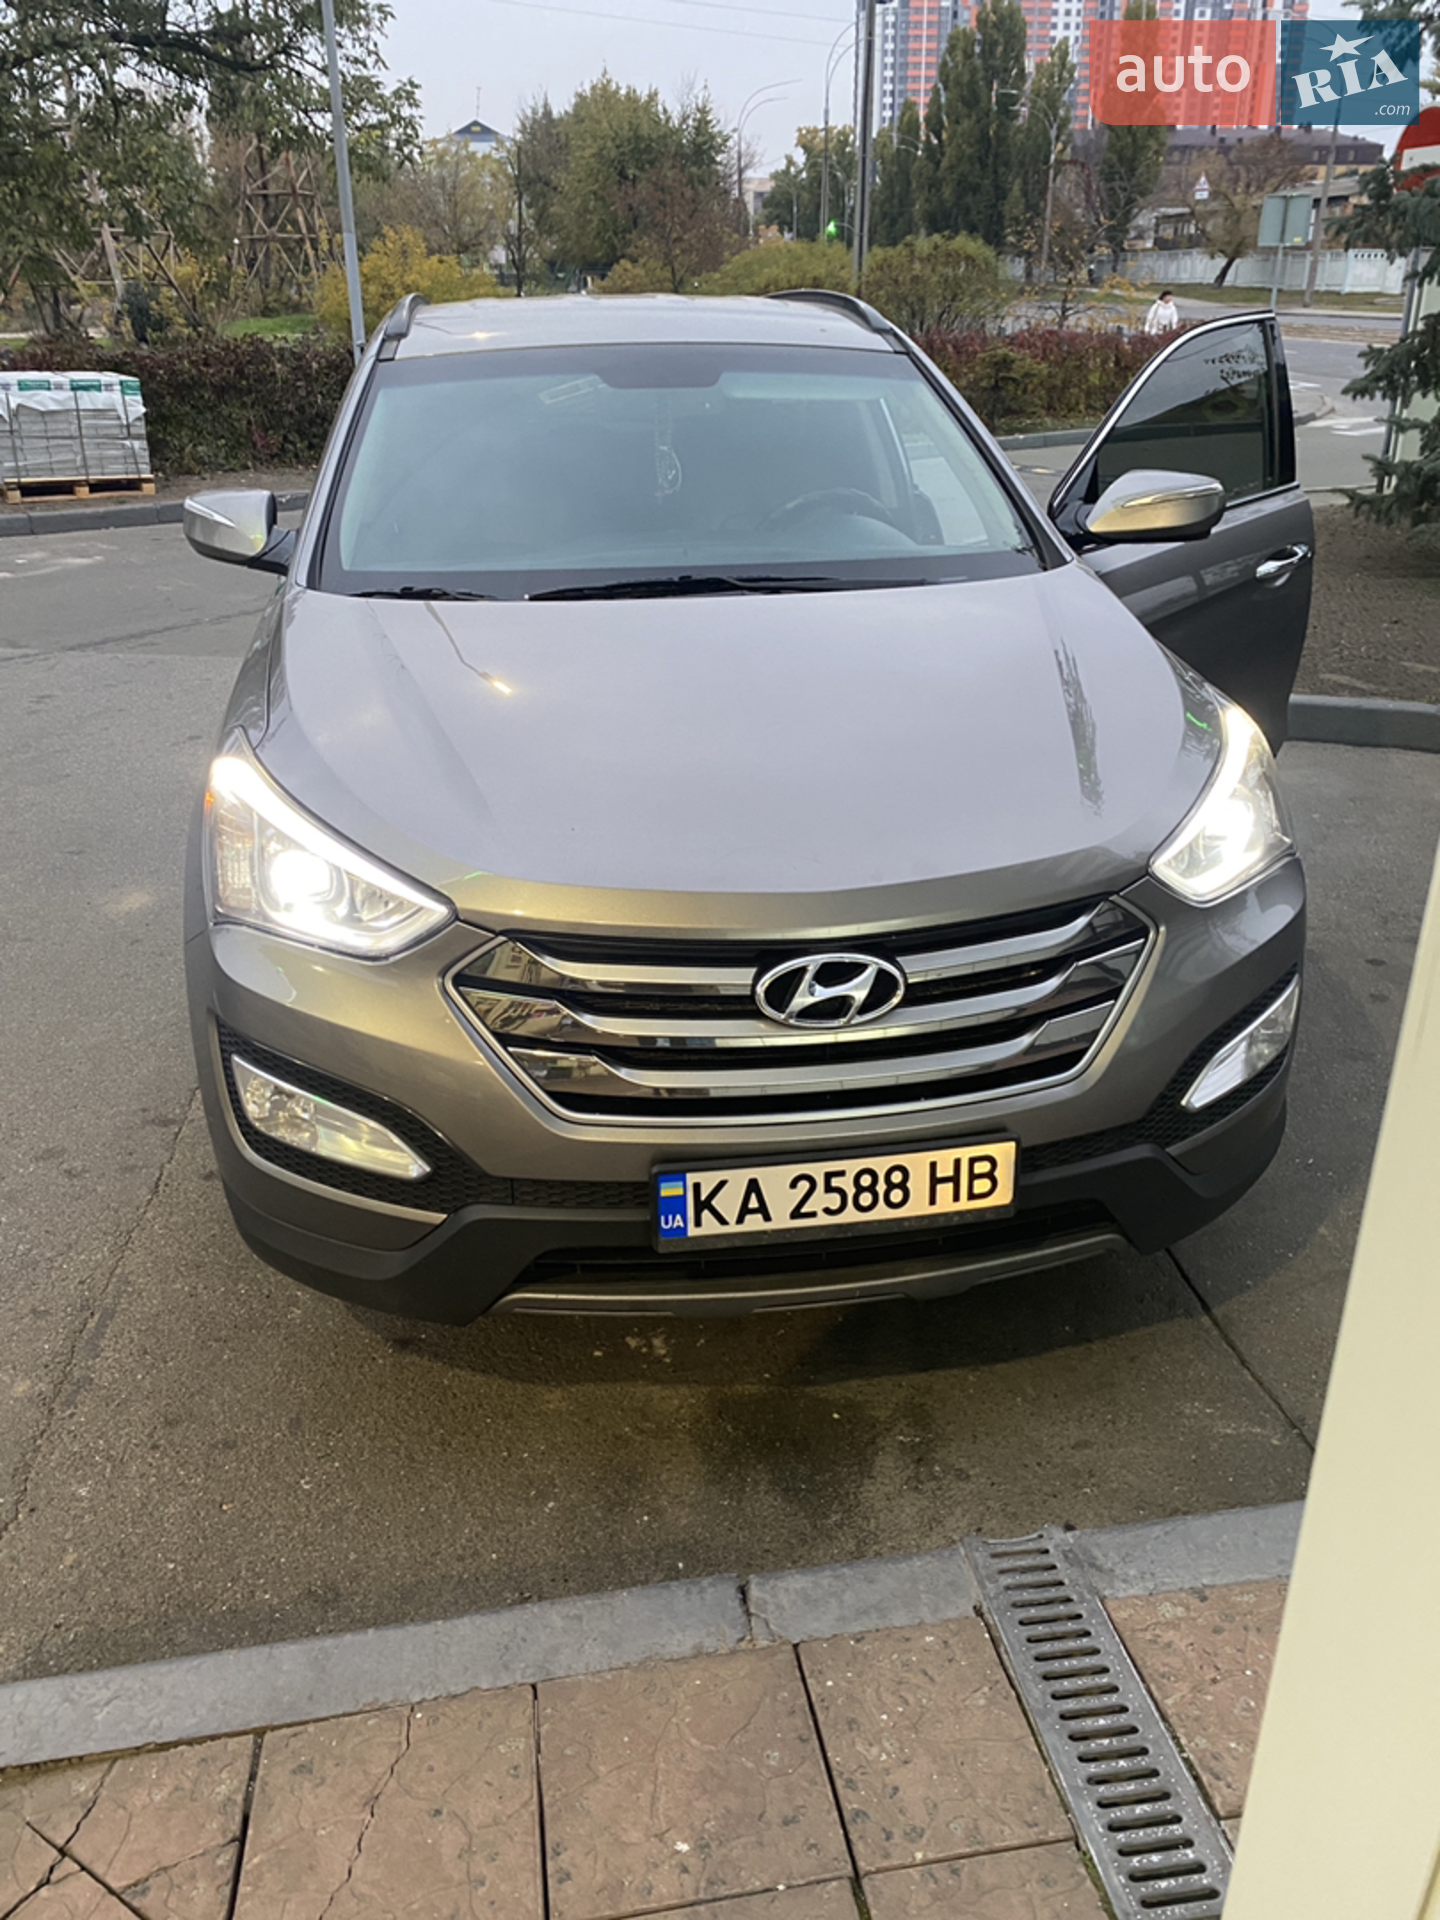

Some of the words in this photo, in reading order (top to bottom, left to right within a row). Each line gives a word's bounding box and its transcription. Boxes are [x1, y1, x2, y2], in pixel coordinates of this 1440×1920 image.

[692, 1177, 772, 1228] KA
[788, 1164, 911, 1220] 2588
[928, 1154, 999, 1206] HB
[660, 1213, 685, 1230] UA
